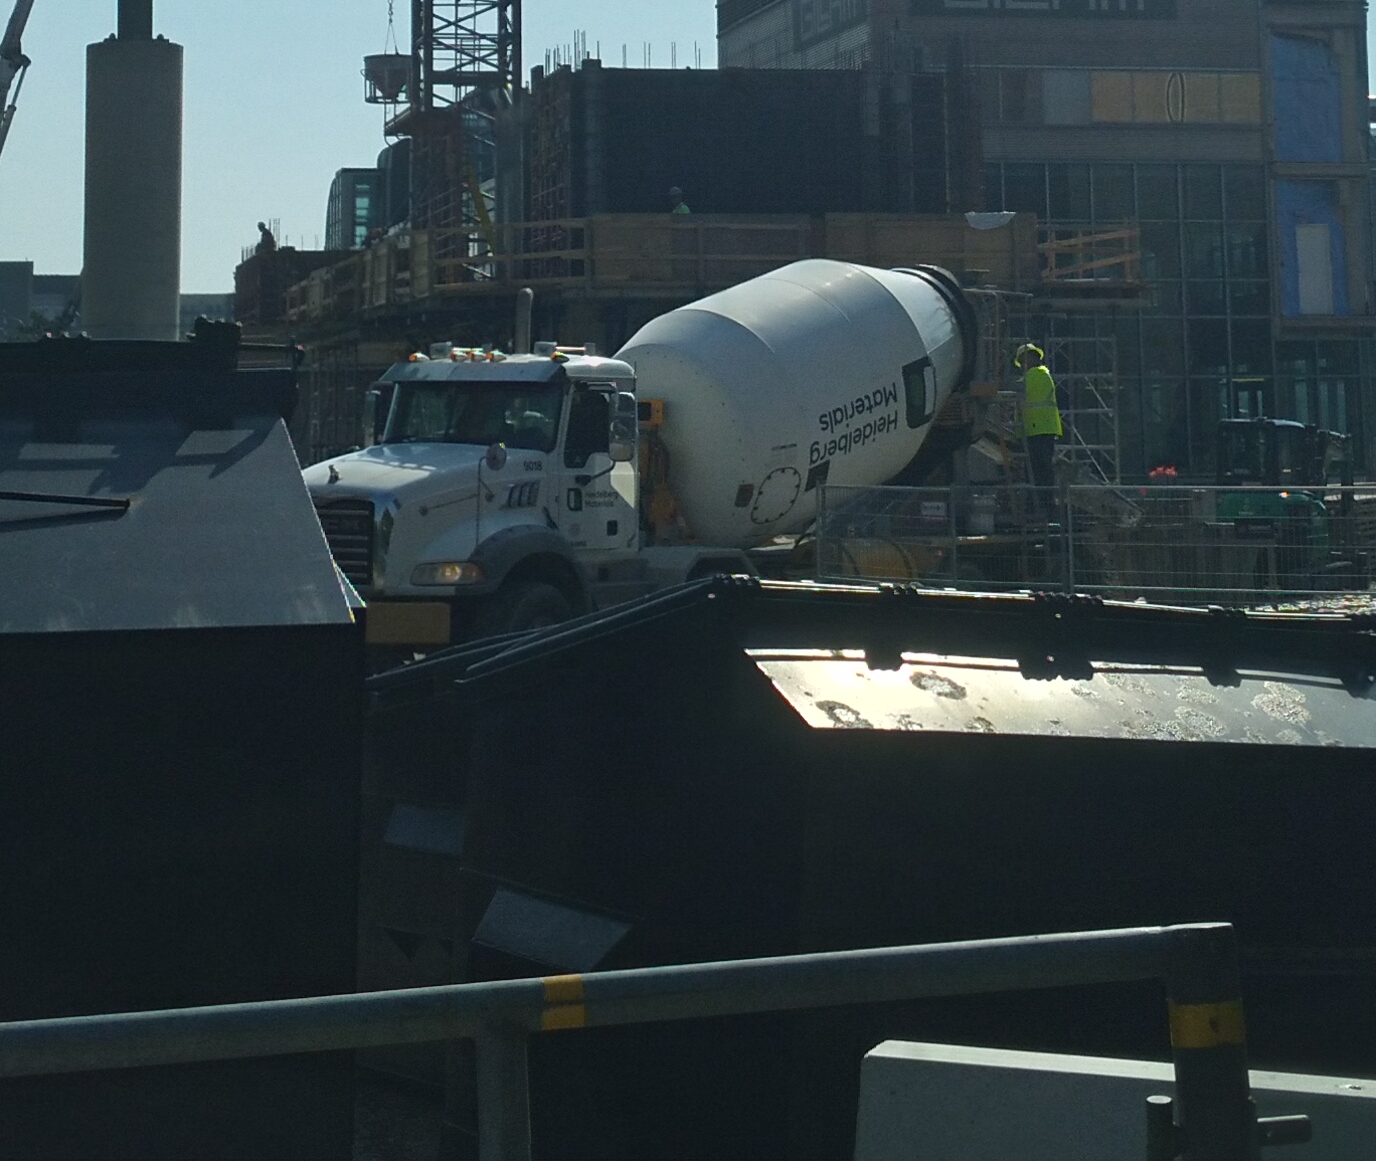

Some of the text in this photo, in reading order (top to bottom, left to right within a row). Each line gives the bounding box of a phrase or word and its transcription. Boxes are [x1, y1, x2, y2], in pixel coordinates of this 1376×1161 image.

[819, 382, 897, 433] Materials
[809, 410, 898, 465] Heidelberg
[524, 460, 542, 471] 9018
